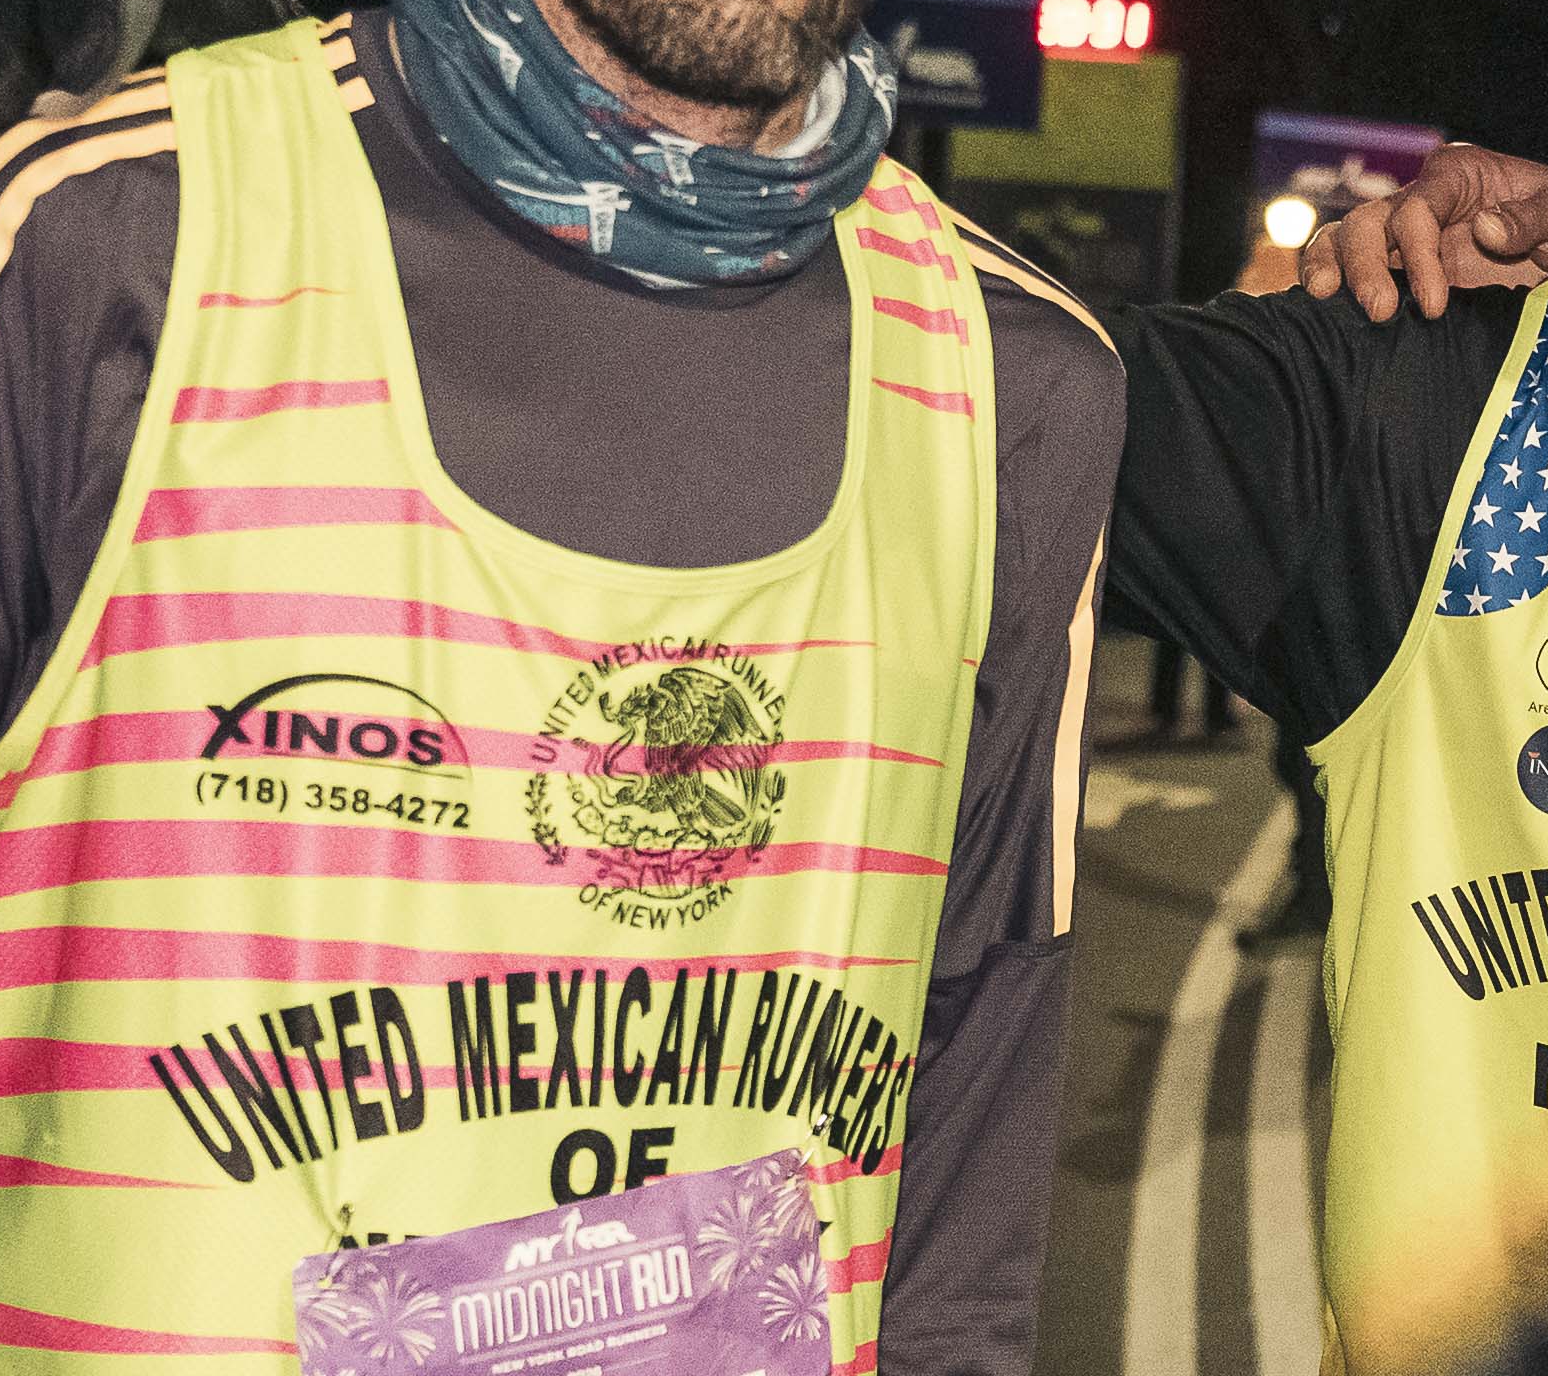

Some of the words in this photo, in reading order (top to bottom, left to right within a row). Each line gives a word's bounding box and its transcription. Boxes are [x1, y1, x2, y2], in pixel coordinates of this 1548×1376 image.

[199, 702, 447, 769] XINOS
[532, 671, 595, 763] UNITED
[195, 772, 289, 814] (718)
[305, 782, 471, 830] 358-4272
[578, 883, 615, 912] OF
[611, 901, 670, 930] NEW
[676, 880, 733, 927] YORK
[148, 985, 426, 1183] UNITED
[448, 966, 739, 1125] MEXICAN
[733, 970, 908, 1177] RUNNERS
[550, 1126, 676, 1206] OF
[453, 1260, 624, 1355] MIDNIGHT
[629, 1245, 693, 1311] RUN
